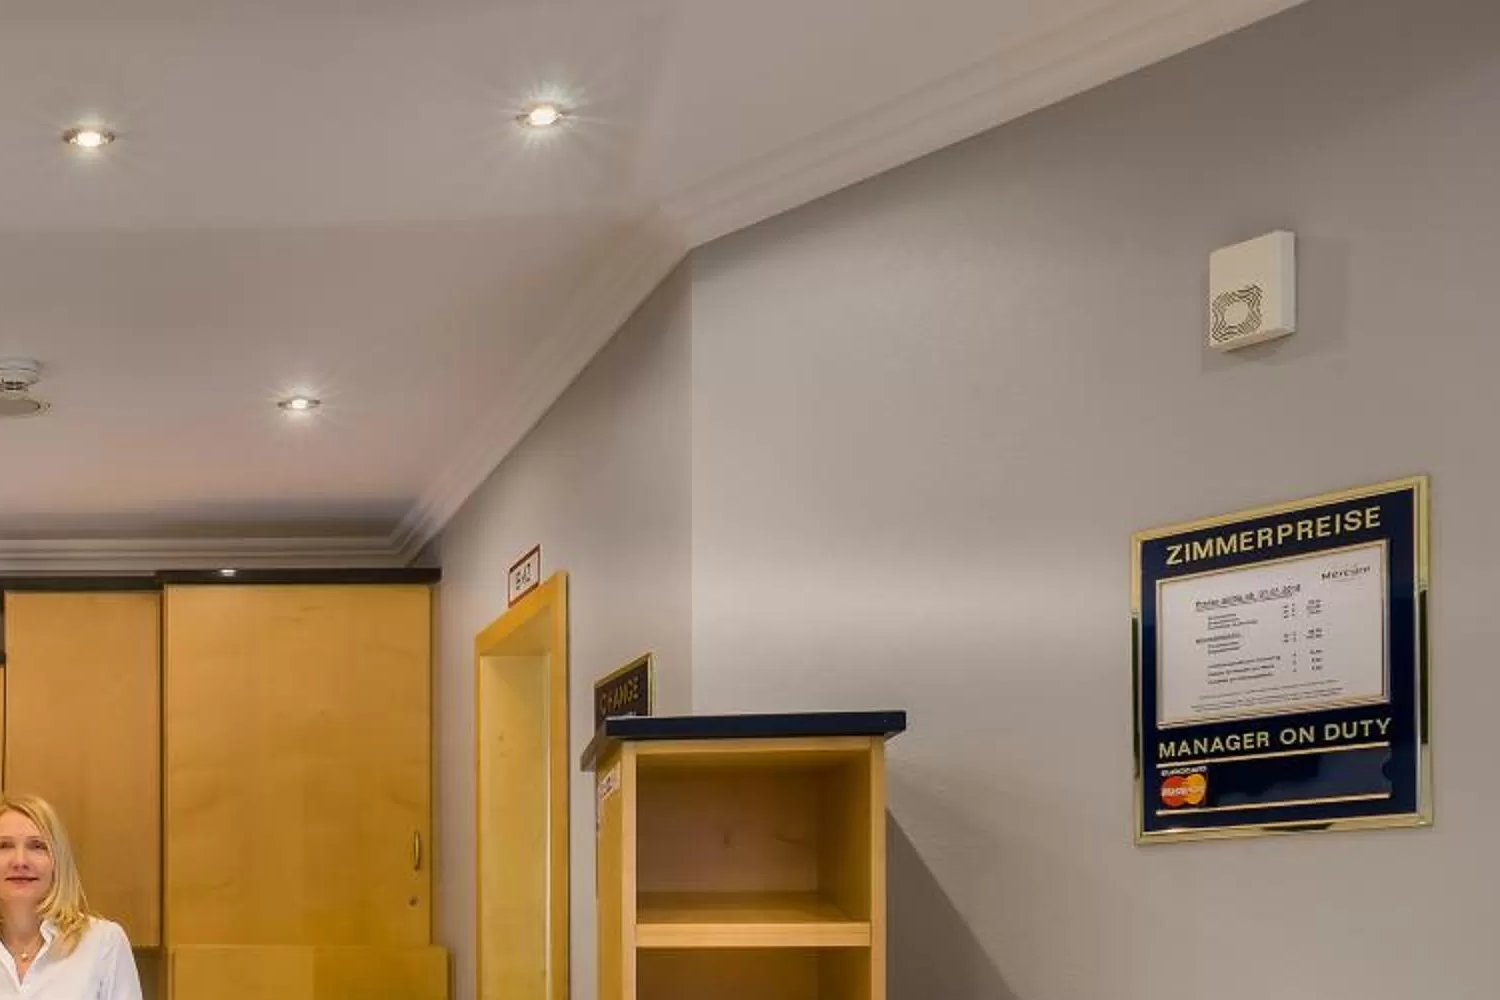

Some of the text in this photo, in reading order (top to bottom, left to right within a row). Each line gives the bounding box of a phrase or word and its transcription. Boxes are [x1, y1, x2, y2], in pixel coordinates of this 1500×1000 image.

[1166, 506, 1382, 566] ZIMMERPREISE
[1158, 717, 1392, 758] MANAGER ON DUTY
